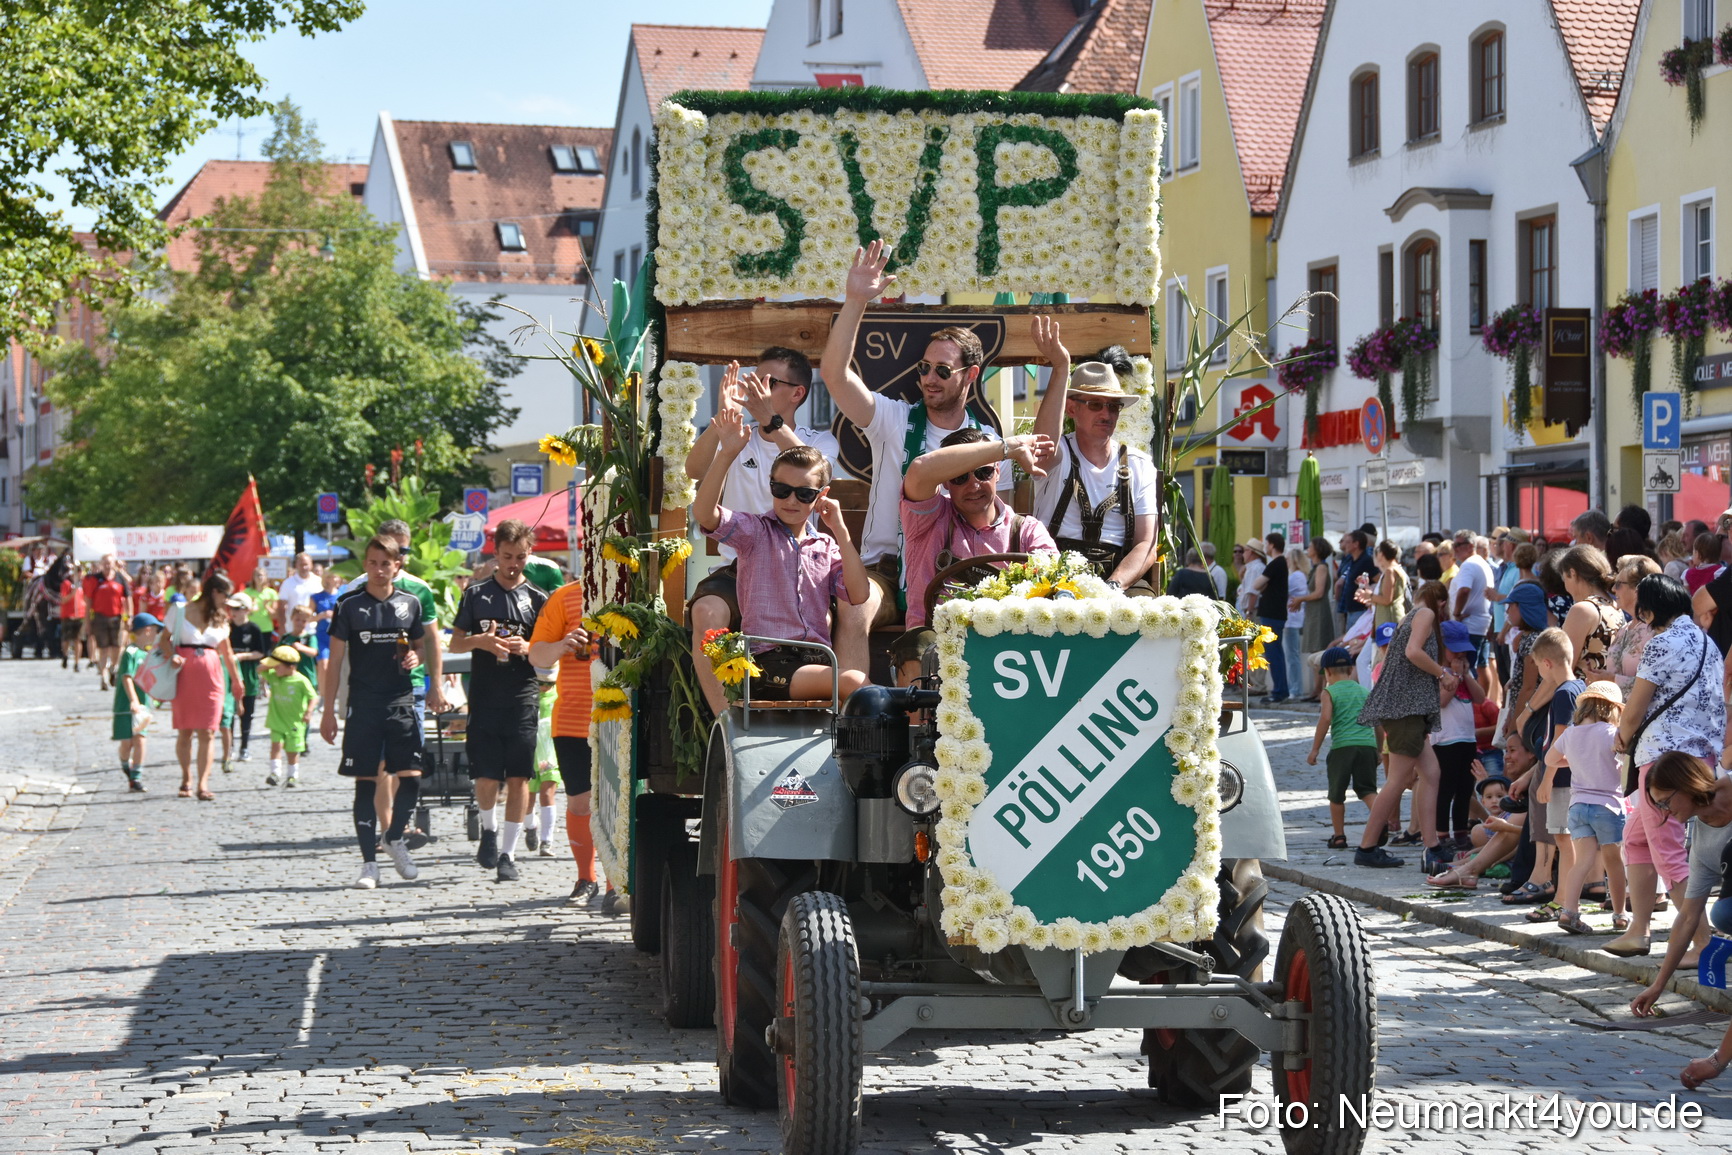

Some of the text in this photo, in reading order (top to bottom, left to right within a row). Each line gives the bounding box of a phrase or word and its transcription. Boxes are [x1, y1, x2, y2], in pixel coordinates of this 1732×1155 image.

[721, 122, 1079, 279] SVP
[865, 331, 908, 361] SV
[1651, 399, 1673, 443] P
[1655, 456, 1667, 465] nur
[458, 520, 472, 530] SV
[971, 566, 994, 577] FENDT
[992, 648, 1071, 700] SV
[993, 678, 1159, 850] PÖLLING
[1076, 806, 1161, 892] 1950
